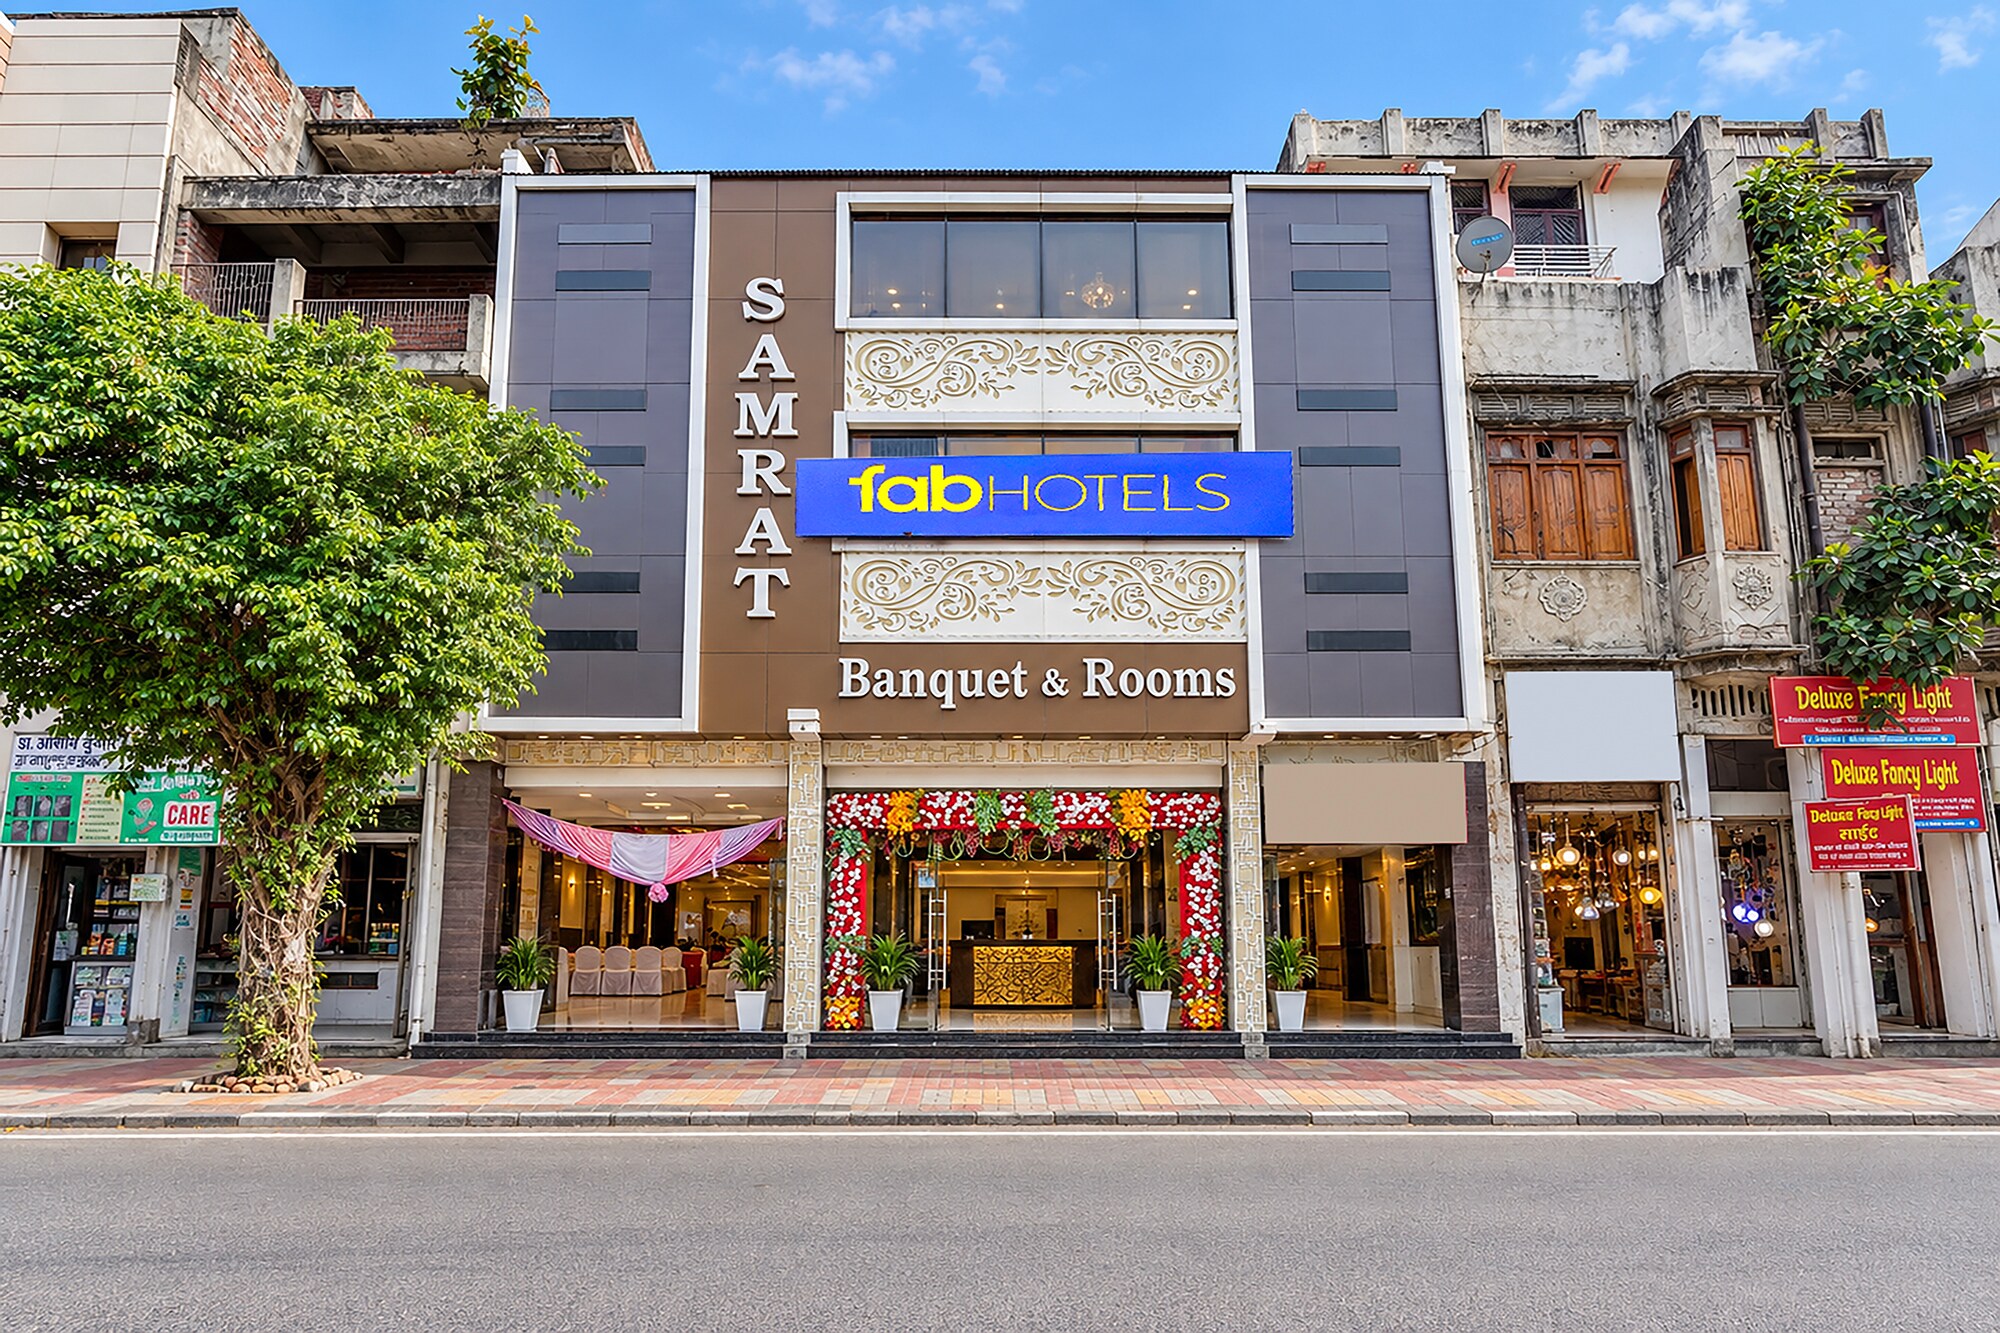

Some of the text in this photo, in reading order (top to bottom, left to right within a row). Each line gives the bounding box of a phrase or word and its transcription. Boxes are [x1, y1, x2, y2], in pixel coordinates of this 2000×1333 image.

[733, 277, 799, 619] SAMRAT
[838, 657, 1237, 709] Banquet & Rooms
[1794, 685, 1854, 711] Deluxe
[1912, 683, 1953, 716] Light
[1831, 758, 1960, 792] Deluxe Fancy Light
[167, 804, 211, 826] CARE
